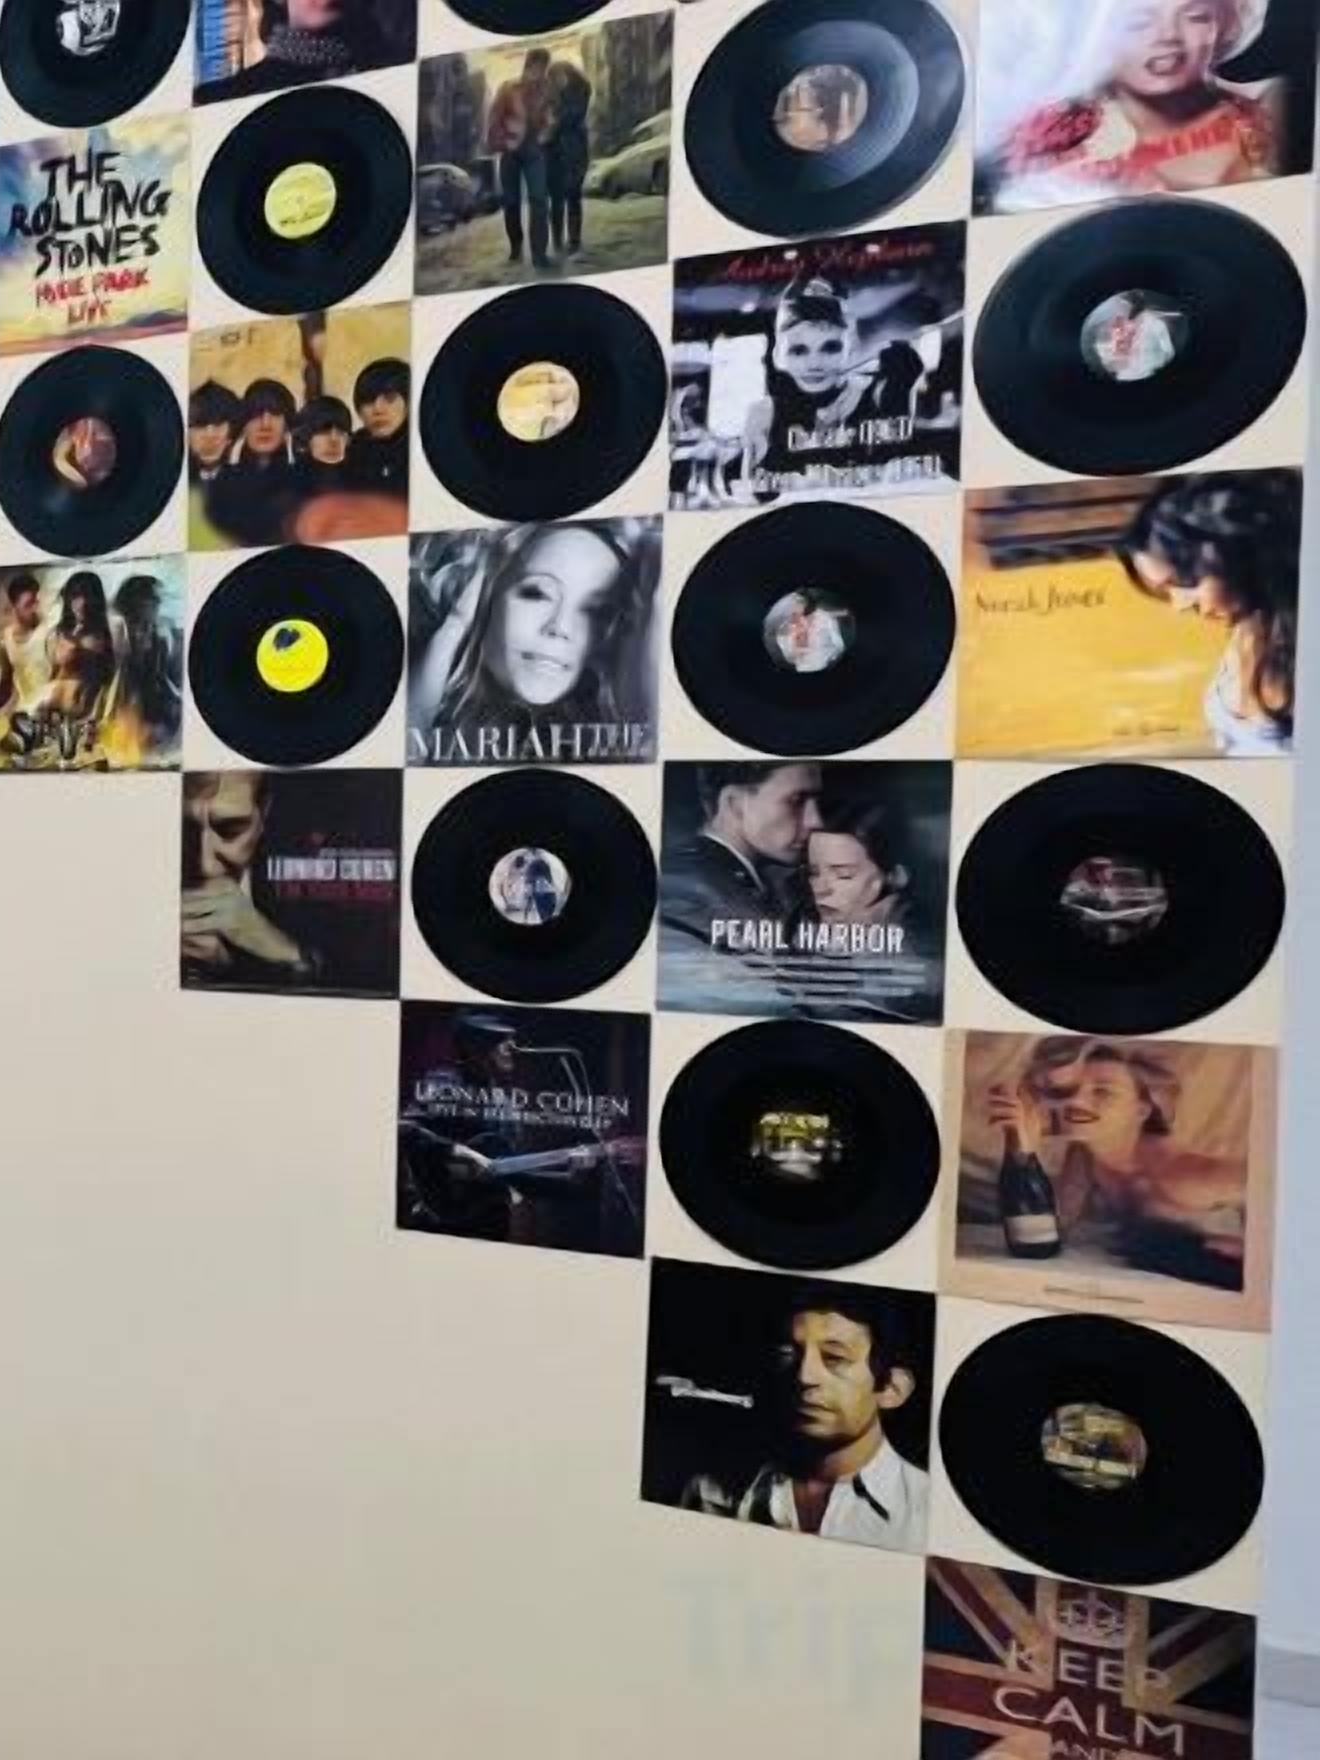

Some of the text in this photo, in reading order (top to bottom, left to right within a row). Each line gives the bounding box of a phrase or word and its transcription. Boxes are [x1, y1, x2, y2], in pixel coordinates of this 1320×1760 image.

[40, 148, 122, 201] THE
[7, 179, 172, 242] ROLLING
[35, 223, 161, 277] STONES
[406, 723, 582, 761] MARIAH
[710, 918, 905, 954] PEARL HARBOR
[415, 1080, 630, 1117] LEONARD COHEN
[1006, 1638, 1173, 1700] KEEP
[993, 1685, 1184, 1757] CALM
